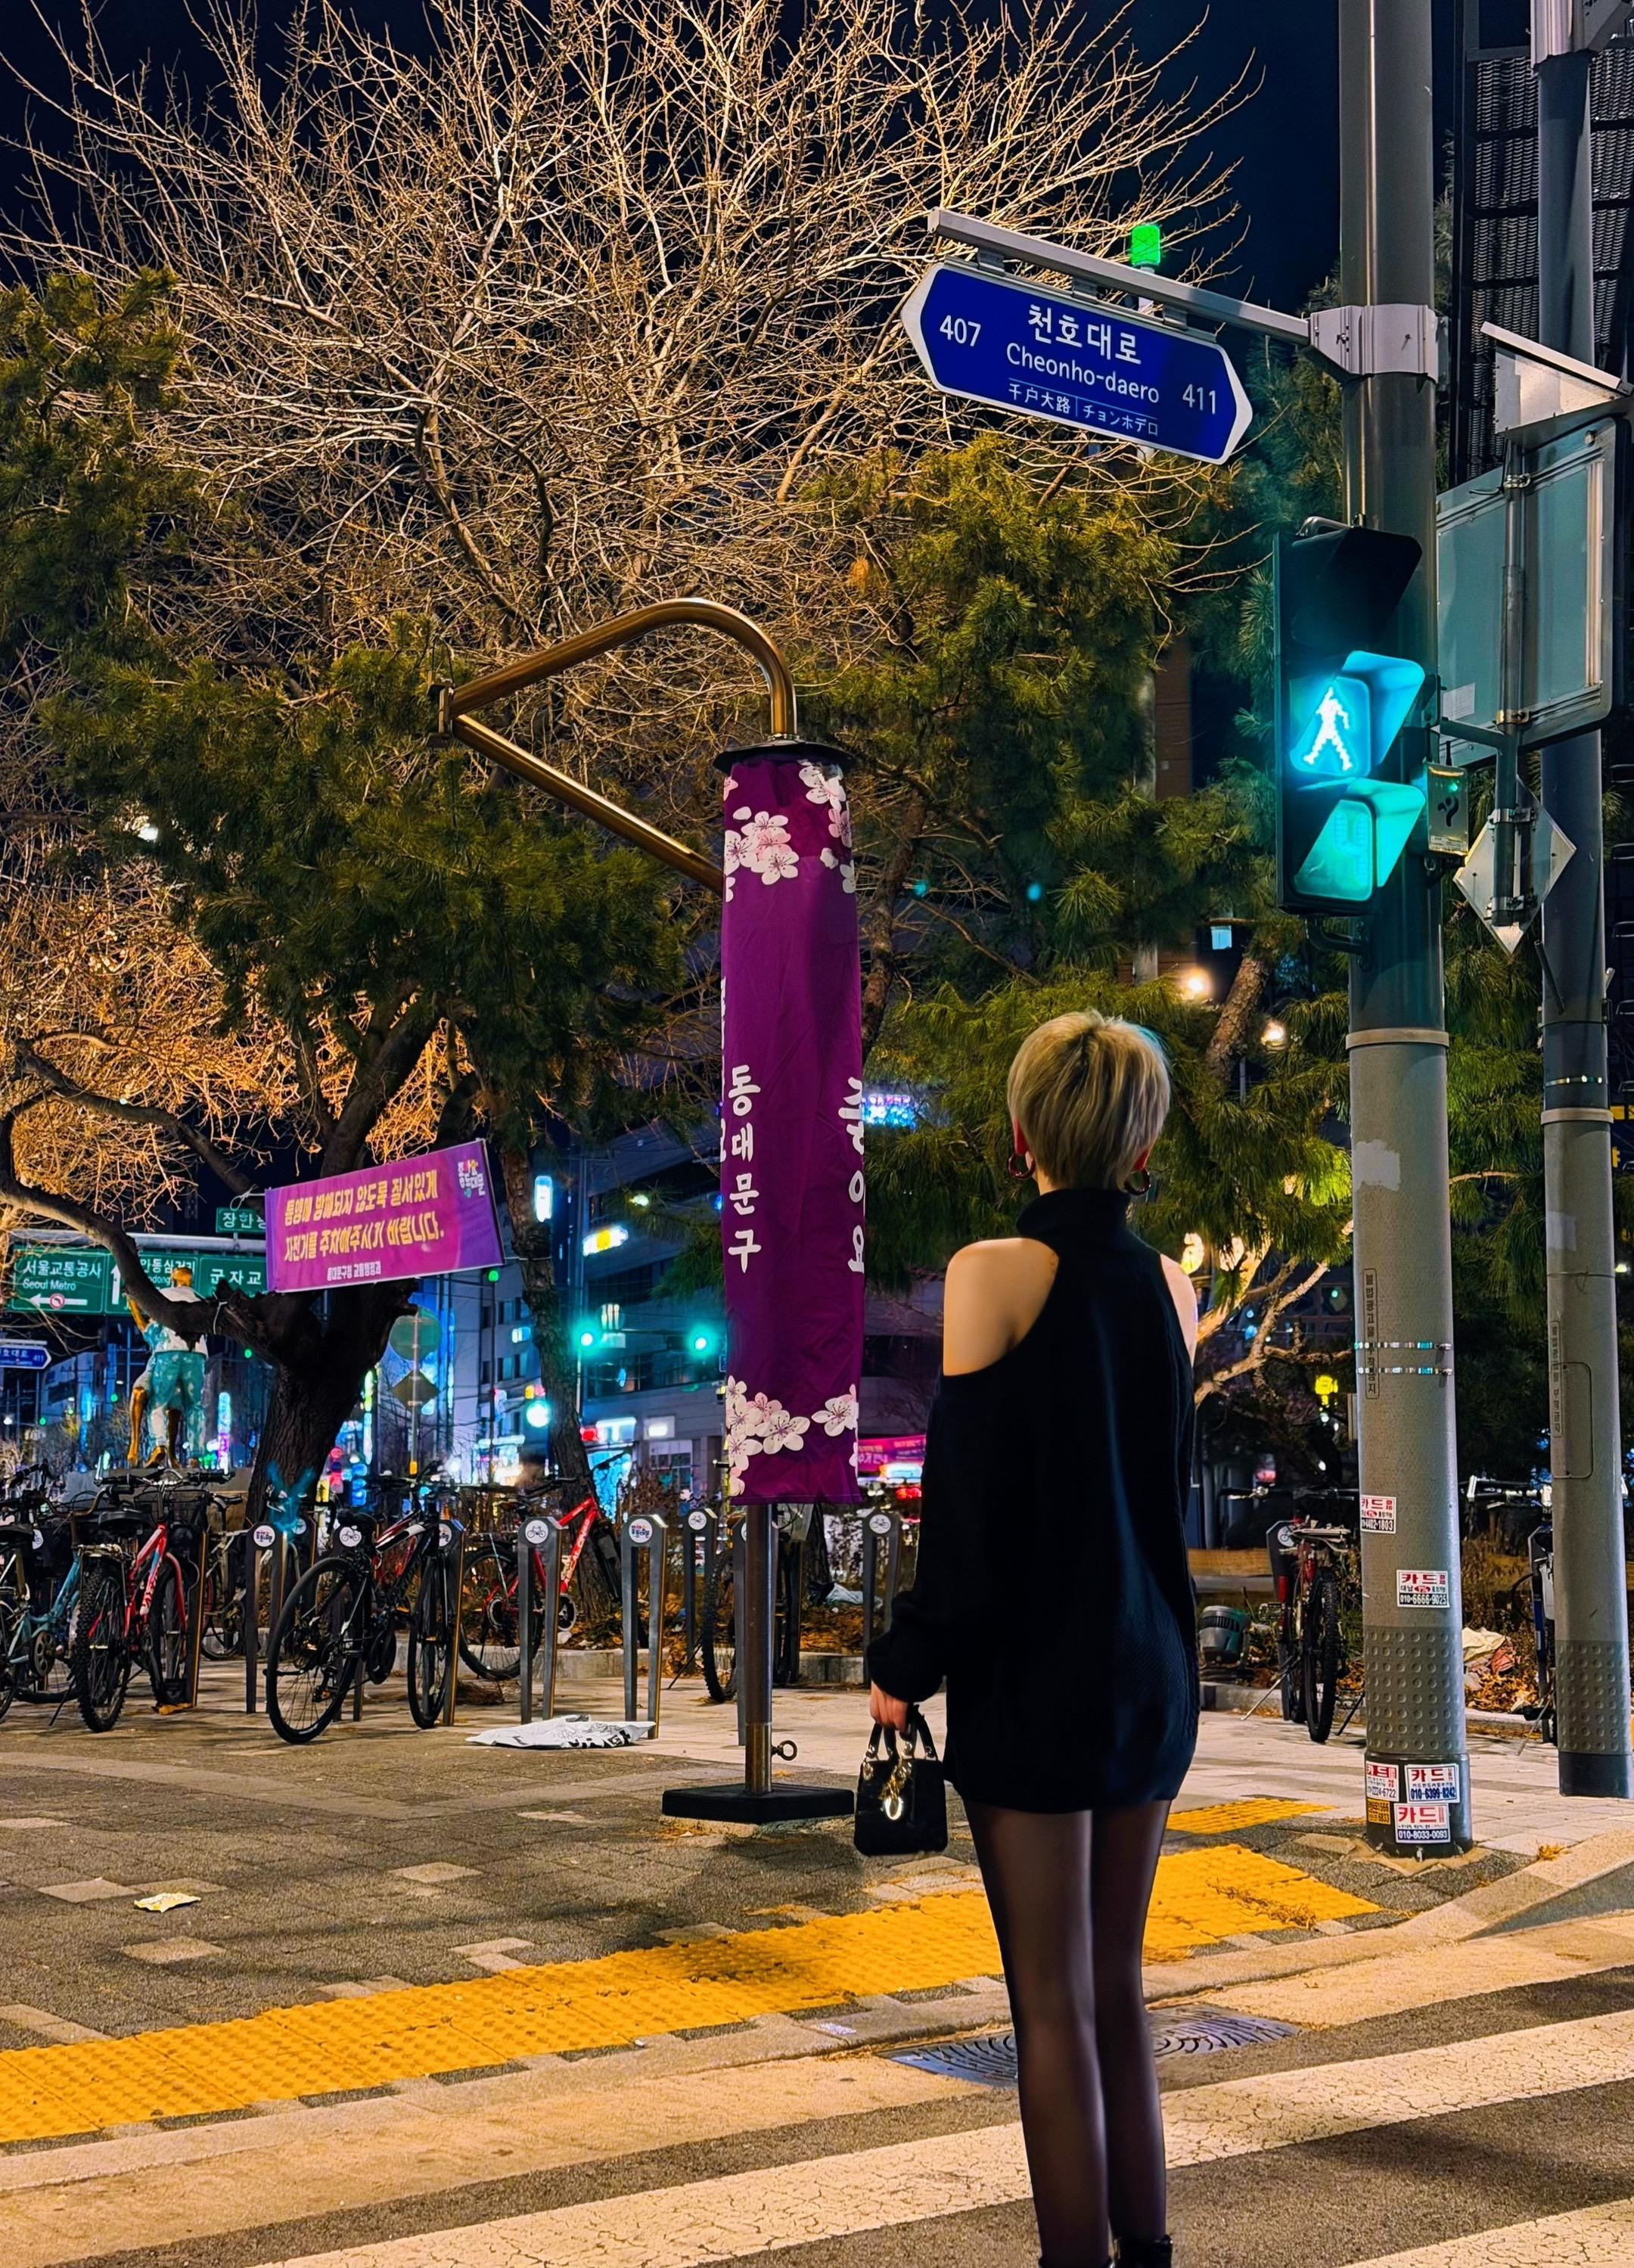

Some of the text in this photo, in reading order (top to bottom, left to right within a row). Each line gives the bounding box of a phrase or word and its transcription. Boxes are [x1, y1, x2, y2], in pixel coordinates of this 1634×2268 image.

[940, 315, 981, 346] 407
[1027, 304, 1142, 365] 천호대로
[1006, 343, 1159, 403] Cheonho-daero
[1182, 384, 1216, 415] 411
[1083, 404, 1158, 437] チョンホデロ
[728, 1064, 762, 1274] 동대문구
[285, 1196, 313, 1226] 통행에
[313, 1188, 354, 1221] 방해되지
[356, 1180, 388, 1213] 않도록
[390, 1170, 438, 1207] 질서있게
[284, 1211, 445, 1262] 자전거를 주차해주시기 바랍니다.
[23, 1260, 102, 1278] 서울교통공사
[210, 1269, 262, 1285] 군자교
[23, 1278, 76, 1291] Seoul Metro
[0, 1349, 28, 1358] 호대로
[1362, 1499, 1384, 1509] 카드
[1401, 1574, 1437, 1585] 카드
[1411, 1768, 1445, 1782] 카드
[1398, 1807, 1437, 1824] 카드
